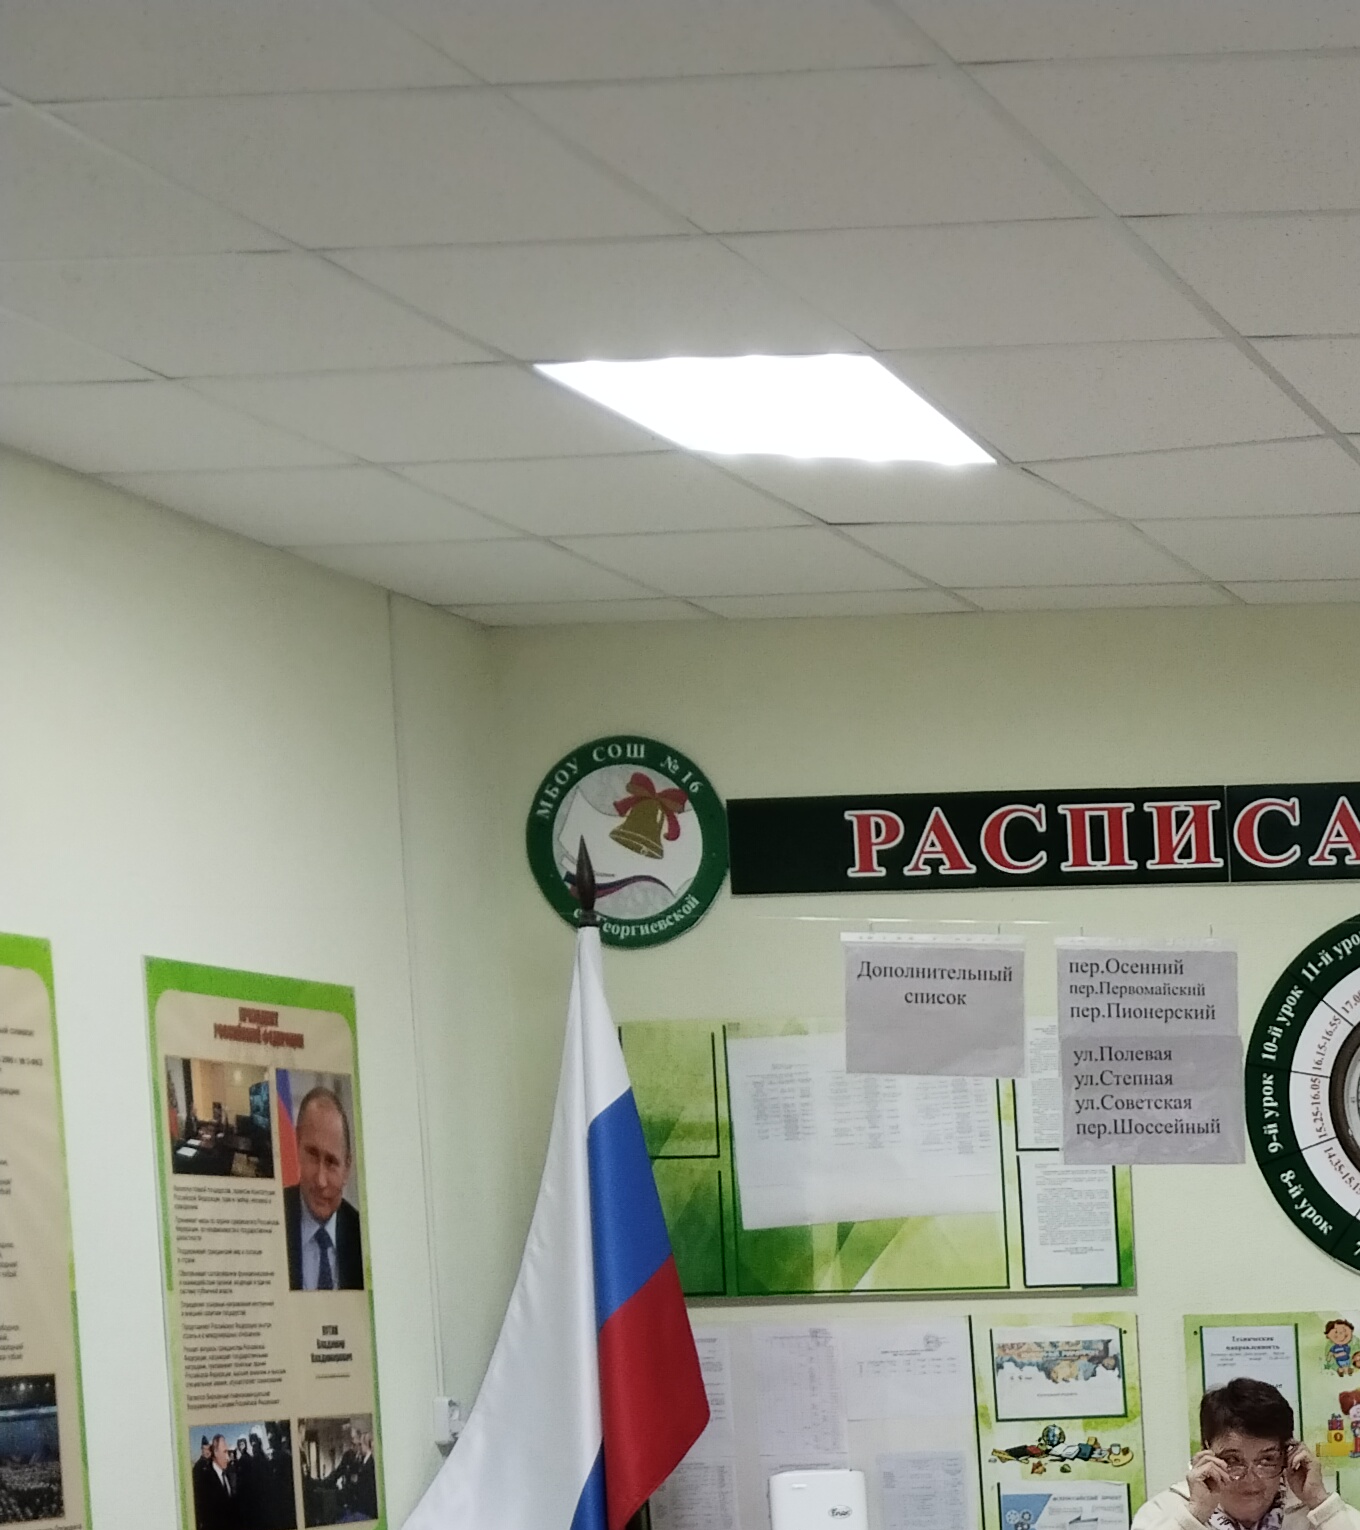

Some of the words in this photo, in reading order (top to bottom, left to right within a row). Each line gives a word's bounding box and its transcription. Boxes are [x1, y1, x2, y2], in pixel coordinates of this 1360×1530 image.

[535, 757, 580, 821] МБОУ
[592, 742, 647, 763] СОШ
[659, 754, 682, 775] №
[678, 770, 703, 795] 16
[857, 960, 1013, 983] Дополнительный
[1068, 958, 1185, 979] пер.Осенний
[1301, 948, 1334, 983] 11-й
[904, 989, 968, 1007] список
[1069, 981, 1206, 997] пер.Первомайский
[1070, 1003, 1217, 1025] пер.Пионерский
[1261, 1025, 1284, 1062] 10-й
[1276, 984, 1305, 1027] урок
[1312, 1015, 1342, 1073] 16.15-16.55
[1073, 1046, 1173, 1067] ул.Полевая
[1074, 1070, 1174, 1089] ул.Степная
[1074, 1094, 1193, 1114] ул.Советская
[1262, 1072, 1280, 1119] урок
[1309, 1077, 1327, 1139] 15.25-16.05
[1076, 1119, 1222, 1140] пер.Шоссейный
[1262, 1122, 1284, 1154] 9-й
[1279, 1169, 1305, 1200] 8-й
[1294, 1197, 1334, 1236] урок
